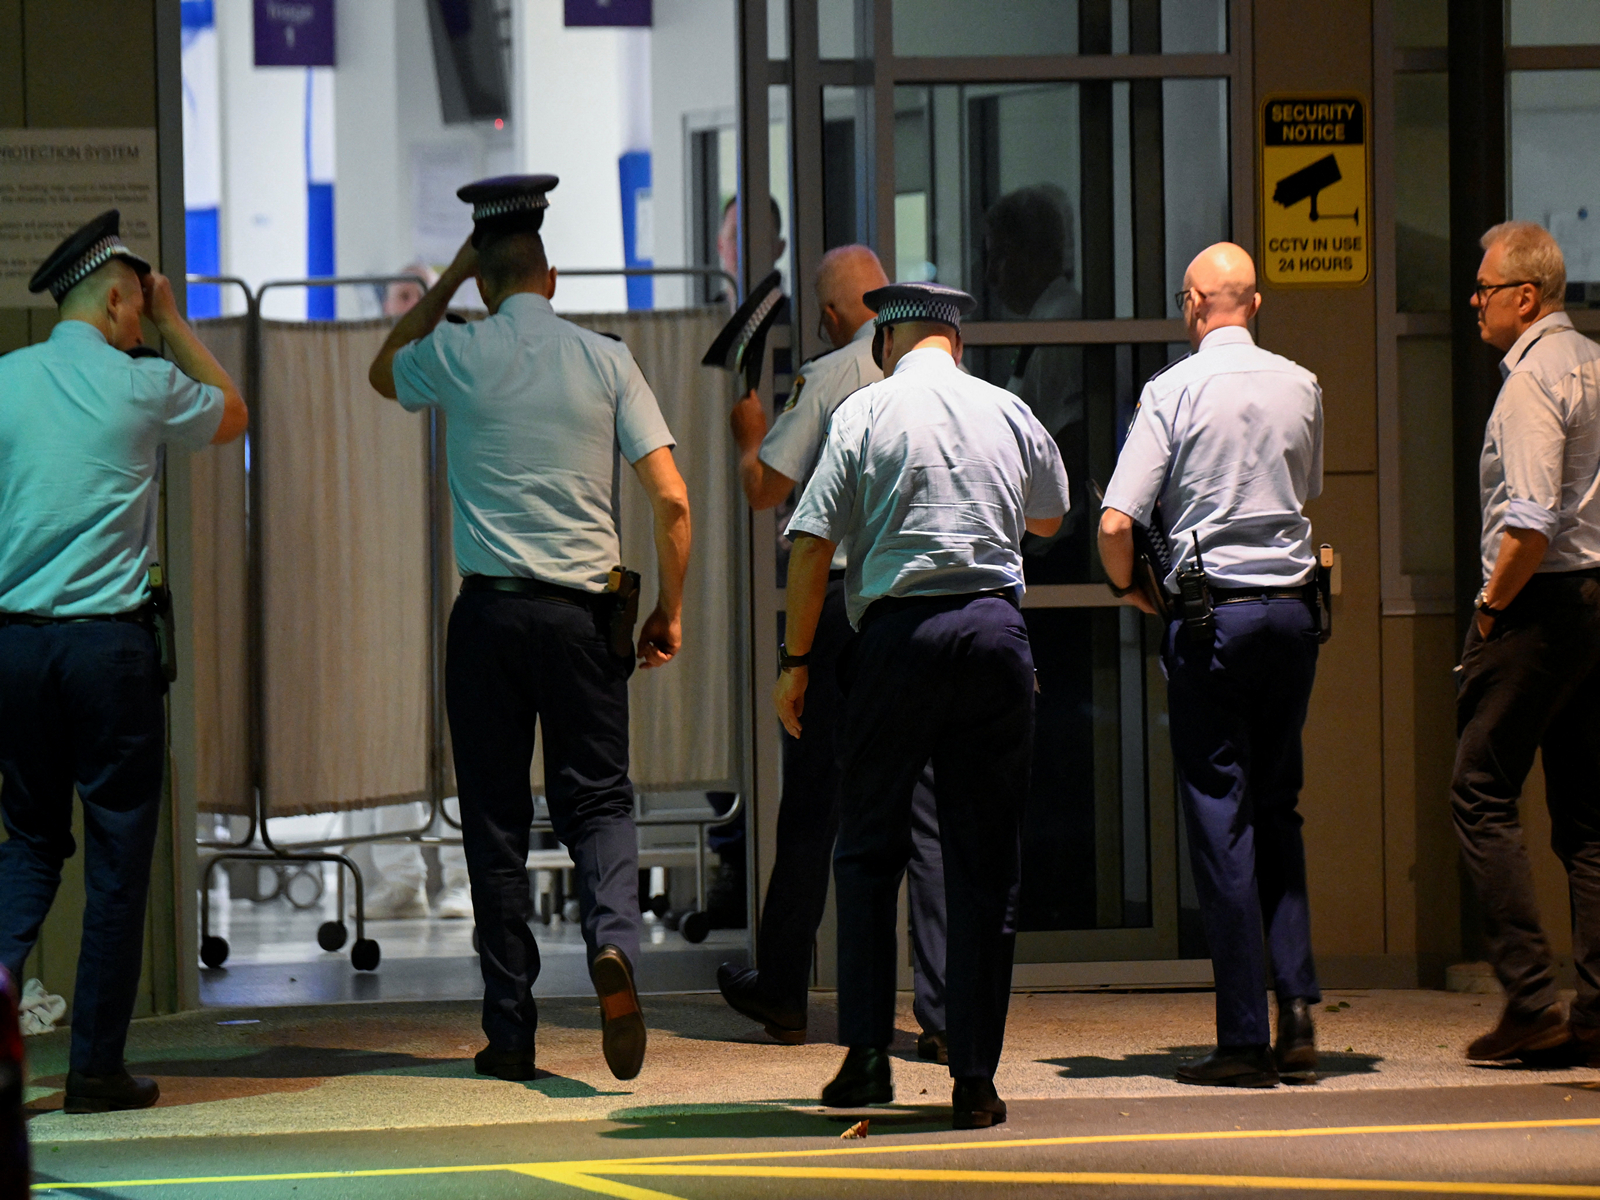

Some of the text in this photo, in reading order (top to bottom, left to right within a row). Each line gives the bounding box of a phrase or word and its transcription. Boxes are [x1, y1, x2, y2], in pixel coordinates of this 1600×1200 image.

[1272, 104, 1355, 122] SECURITY
[1282, 123, 1345, 141] NOTICE
[84, 144, 139, 161] SYSTEM
[1268, 236, 1362, 252] CCTV IN USE
[1278, 256, 1353, 272] 24 HOURS
